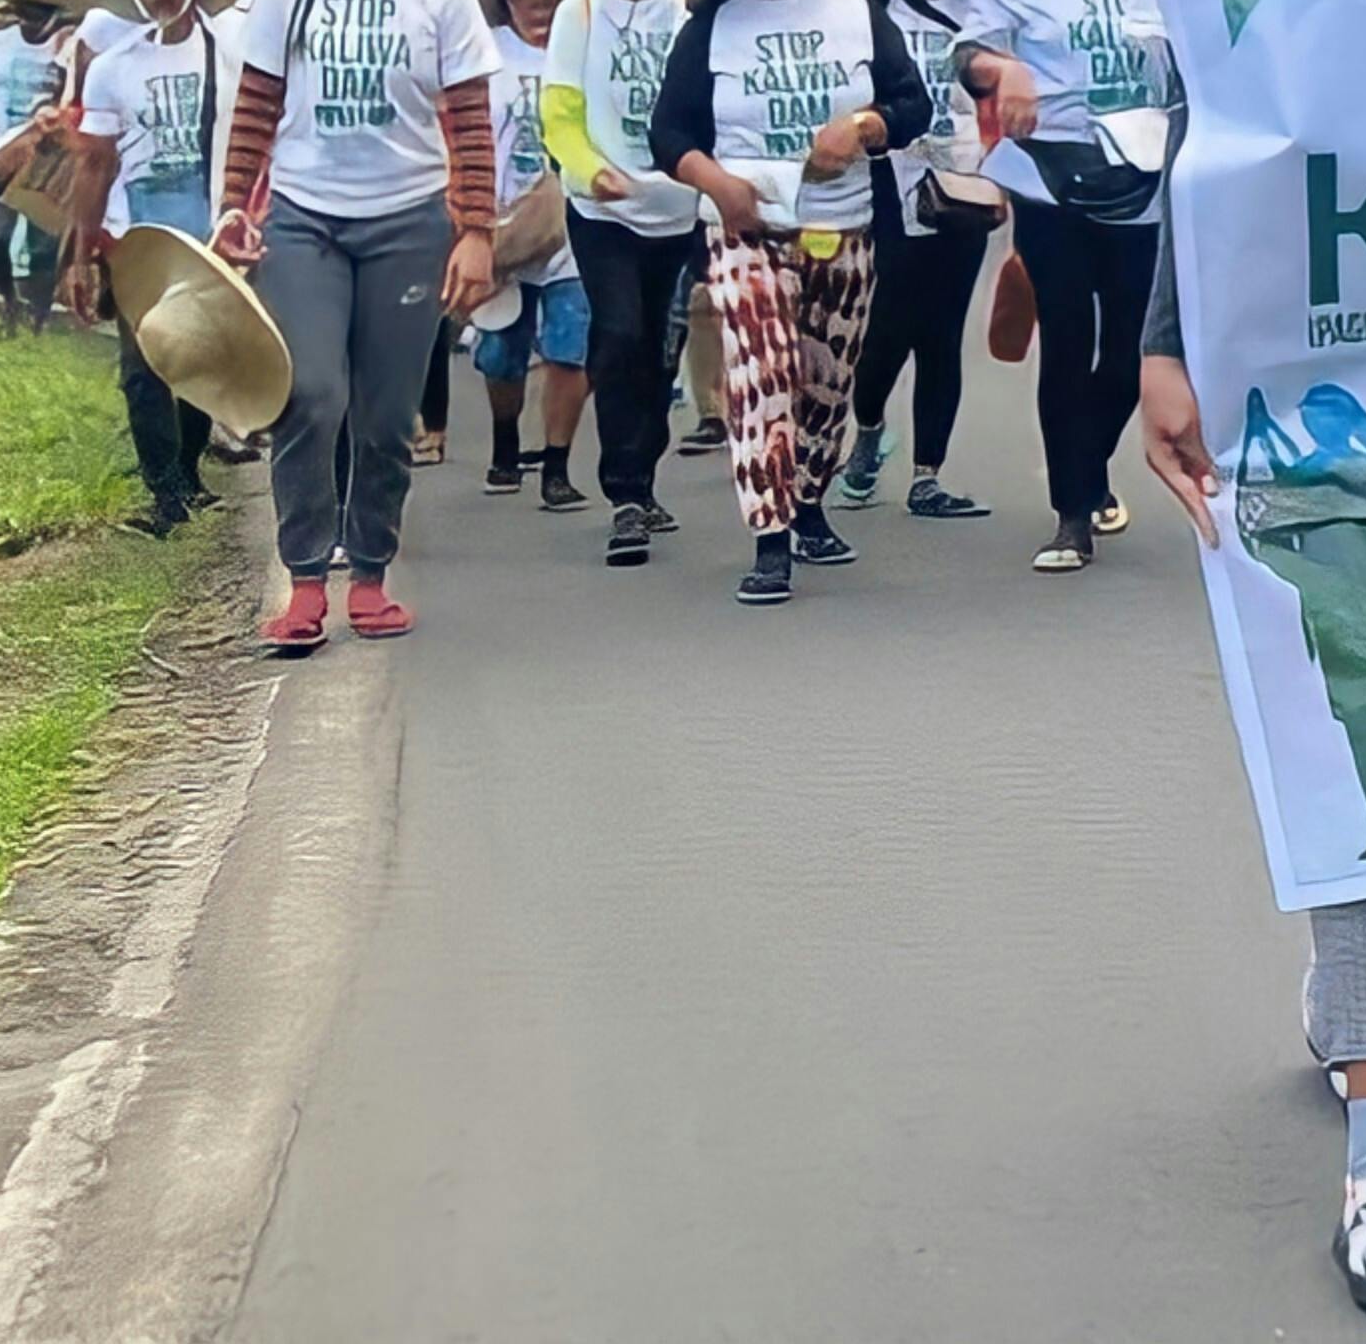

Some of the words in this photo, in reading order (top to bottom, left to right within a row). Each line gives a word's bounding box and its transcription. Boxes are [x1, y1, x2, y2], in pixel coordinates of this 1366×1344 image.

[755, 30, 825, 60] STOP
[322, 65, 387, 102] DAM
[768, 93, 831, 129] DAM
